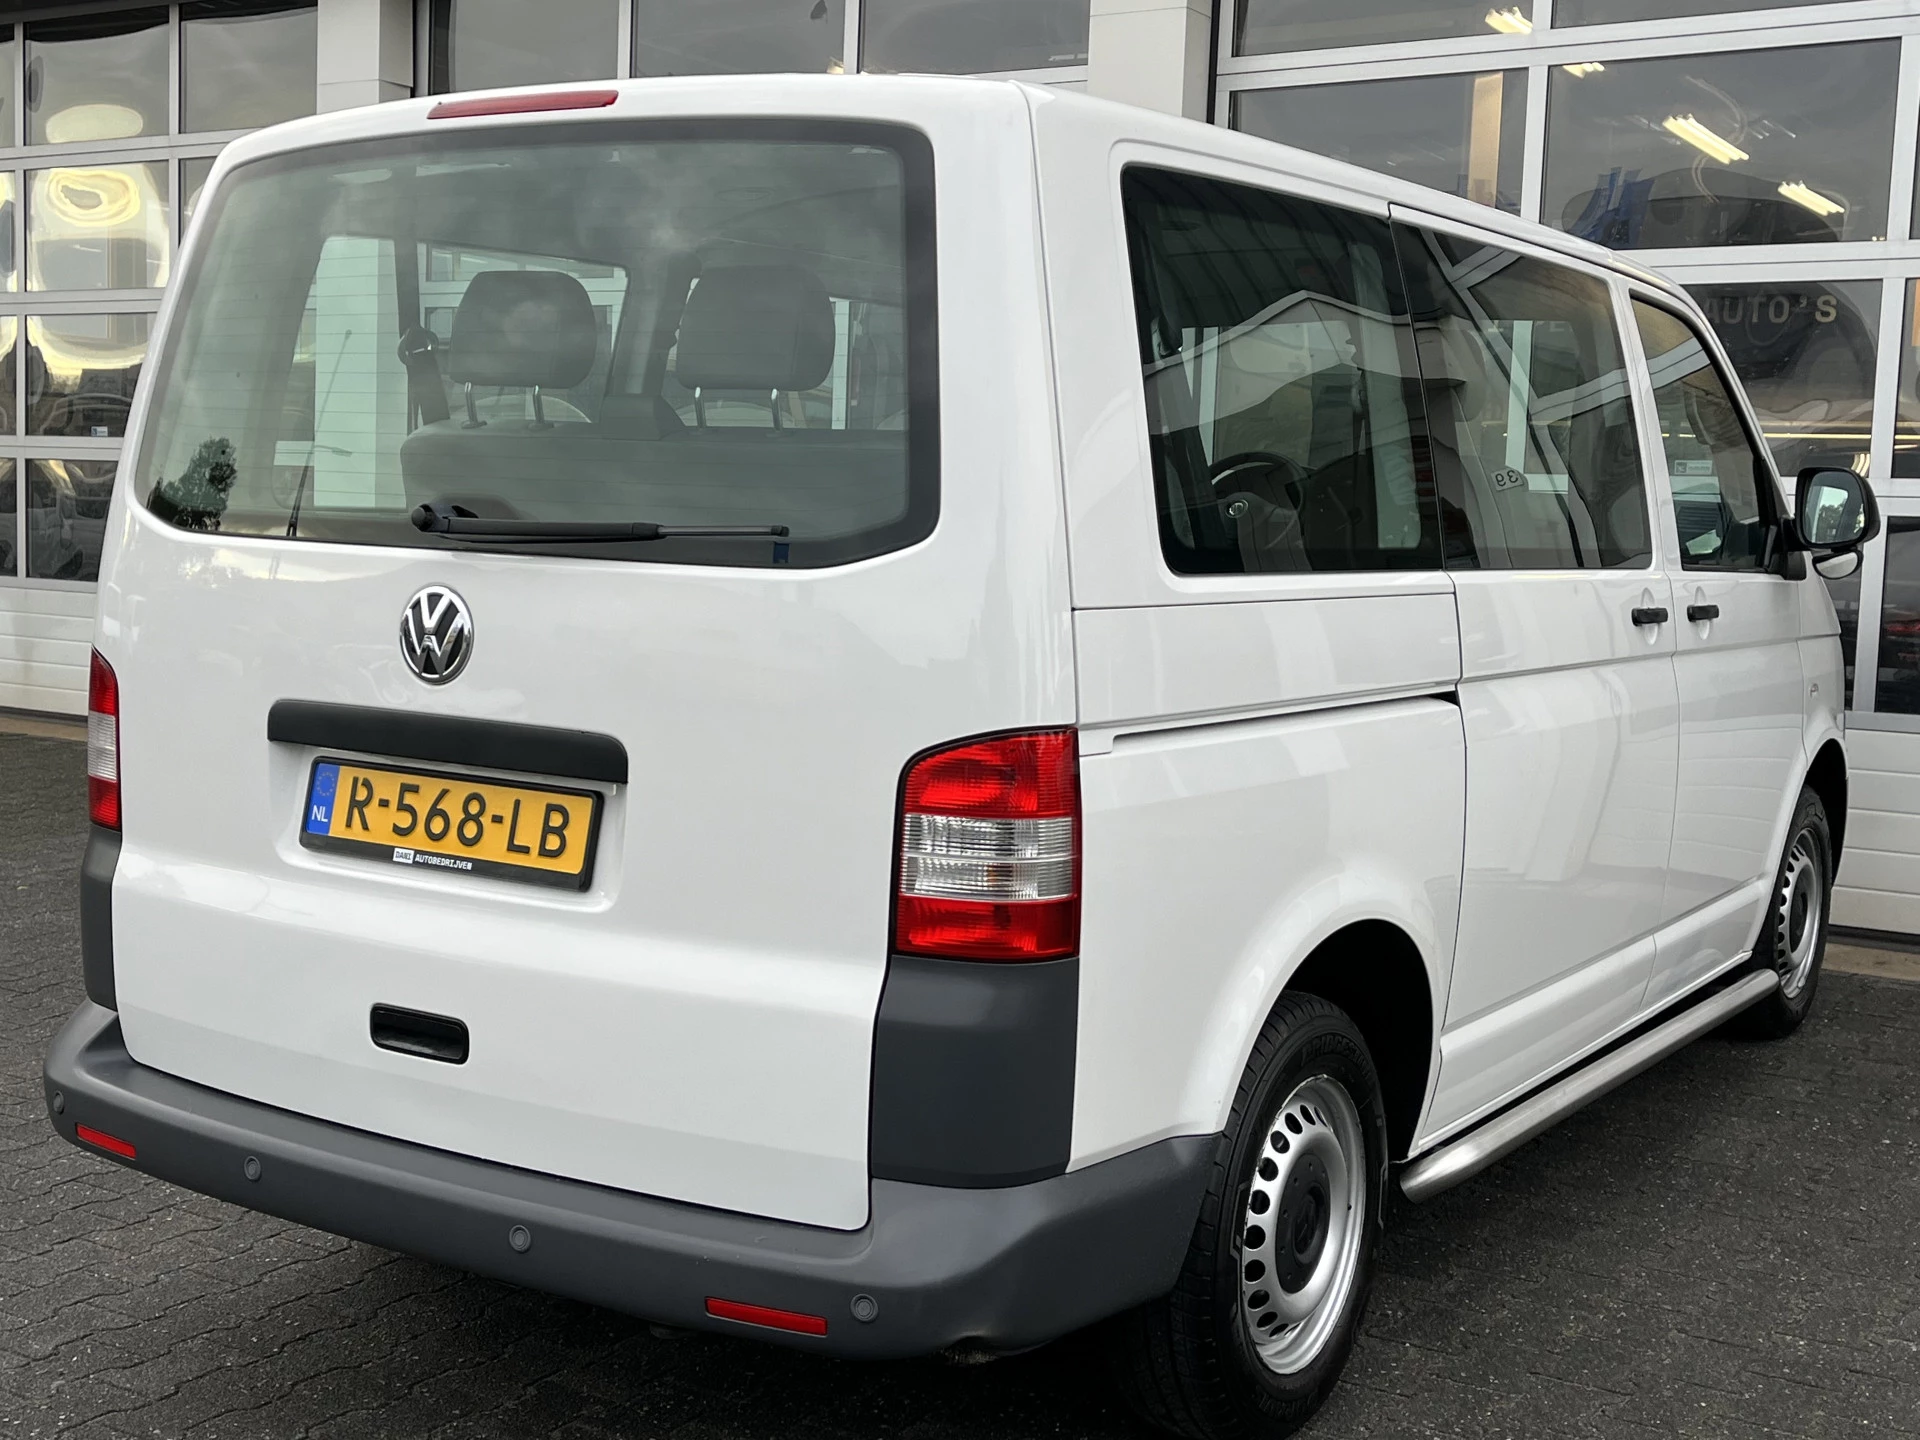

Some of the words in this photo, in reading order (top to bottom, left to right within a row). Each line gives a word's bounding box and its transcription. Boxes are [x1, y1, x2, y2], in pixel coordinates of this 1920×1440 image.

[400, 585, 474, 686] VW
[311, 804, 328, 823] NL
[345, 776, 570, 858] R-568-LB
